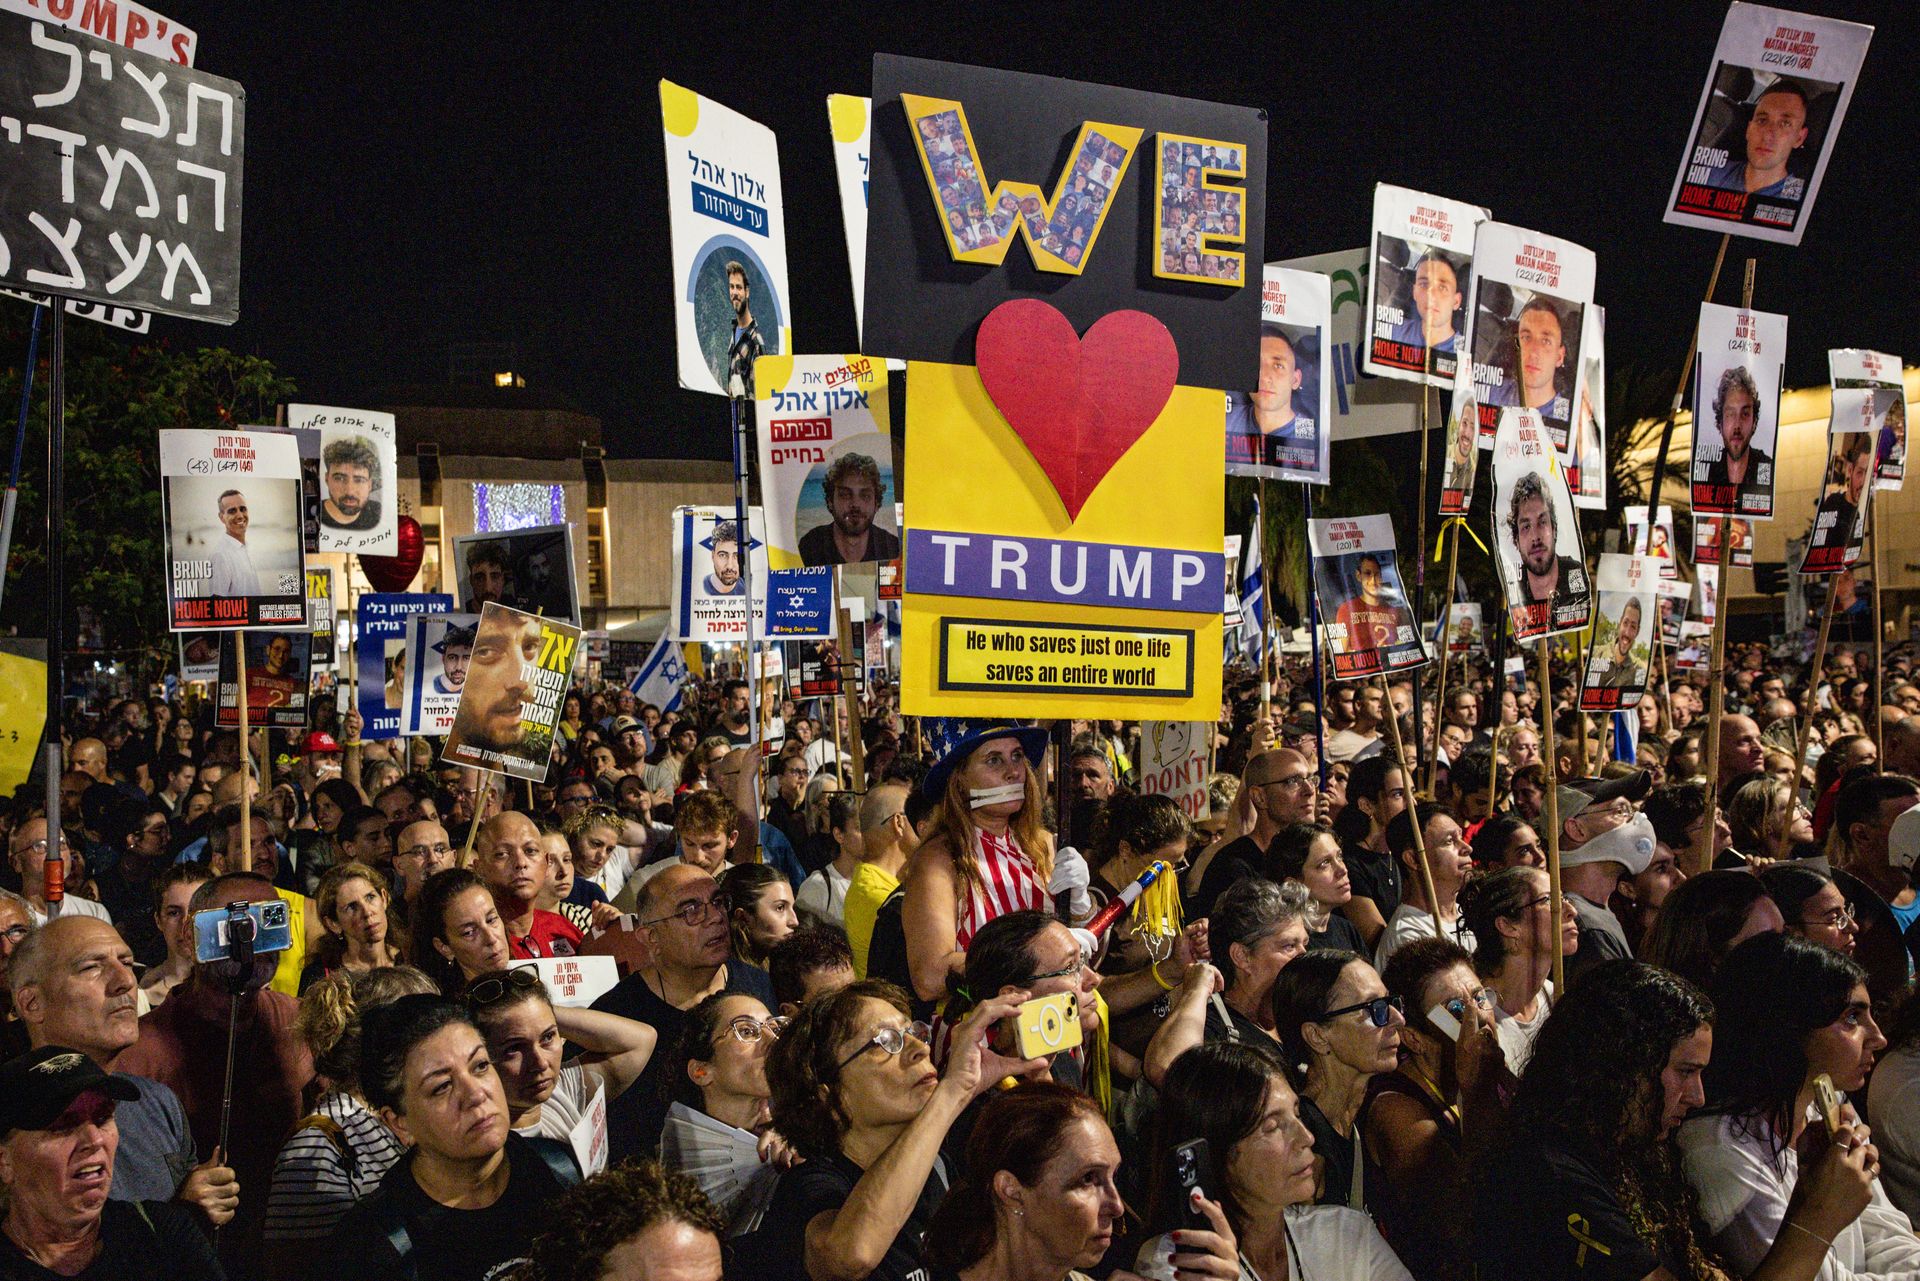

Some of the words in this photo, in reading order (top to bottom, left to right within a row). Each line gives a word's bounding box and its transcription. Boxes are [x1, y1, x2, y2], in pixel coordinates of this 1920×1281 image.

[28, 0, 190, 67] UMP'S
[1763, 37, 1788, 51] MATAN
[1692, 146, 1729, 169] BRING
[688, 150, 726, 188] אהל
[1686, 164, 1712, 185] HIM
[731, 170, 766, 204] אלון
[900, 92, 1247, 288] WE
[699, 191, 743, 221] שיחזור
[1680, 184, 1714, 208] HOME
[1713, 190, 1749, 213] NOW!
[746, 209, 763, 229] עד
[1410, 215, 1428, 226] MATAN
[1515, 254, 1536, 269] MATAN
[1536, 260, 1561, 277] ANGREST
[1262, 291, 1287, 304] NGREST
[1376, 304, 1404, 325] BRING
[1376, 322, 1393, 340] HIM
[1374, 339, 1399, 359] HOME
[802, 372, 822, 384] את
[1473, 362, 1504, 386] BRING
[770, 388, 818, 412] אהל
[823, 387, 870, 417] אלון
[773, 421, 828, 439] הביתה
[213, 447, 233, 459] OMRI
[234, 449, 256, 460] MIRAN
[770, 447, 826, 465] בחיים
[1695, 443, 1723, 462] BRING
[1693, 462, 1711, 481] HIM
[1336, 540, 1352, 551] (20)
[173, 560, 213, 581] BRING
[931, 535, 1206, 601] TRUMP
[174, 579, 200, 598] HIM
[175, 600, 212, 619] HOME
[214, 597, 249, 618] NOW!
[366, 602, 387, 614] בלי
[390, 603, 424, 616] ניצחון
[428, 602, 446, 614] אין
[694, 608, 721, 619] לחזור
[724, 610, 746, 619] רוצה
[785, 610, 807, 618] ישראל
[366, 620, 400, 634] גולדין
[707, 621, 748, 632] הביתה
[537, 625, 574, 674] אל
[966, 630, 986, 650] He
[991, 632, 1025, 652] who
[1029, 636, 1076, 654] saves
[1080, 637, 1110, 657] just
[1114, 640, 1143, 656] one
[1147, 638, 1171, 658] life
[1334, 654, 1353, 671] HOME
[520, 663, 564, 690] תשאירו
[986, 663, 1034, 682] saves
[1038, 665, 1058, 683] an
[1062, 665, 1108, 685] entire
[1112, 667, 1156, 686] world
[533, 685, 560, 709] אותי
[424, 705, 449, 715] לחזור
[520, 701, 555, 726] מאחור
[1143, 749, 1207, 799] DON'T
[553, 975, 566, 985] ITAY
[566, 973, 583, 984] CHEN
[562, 985, 576, 997] (19)
